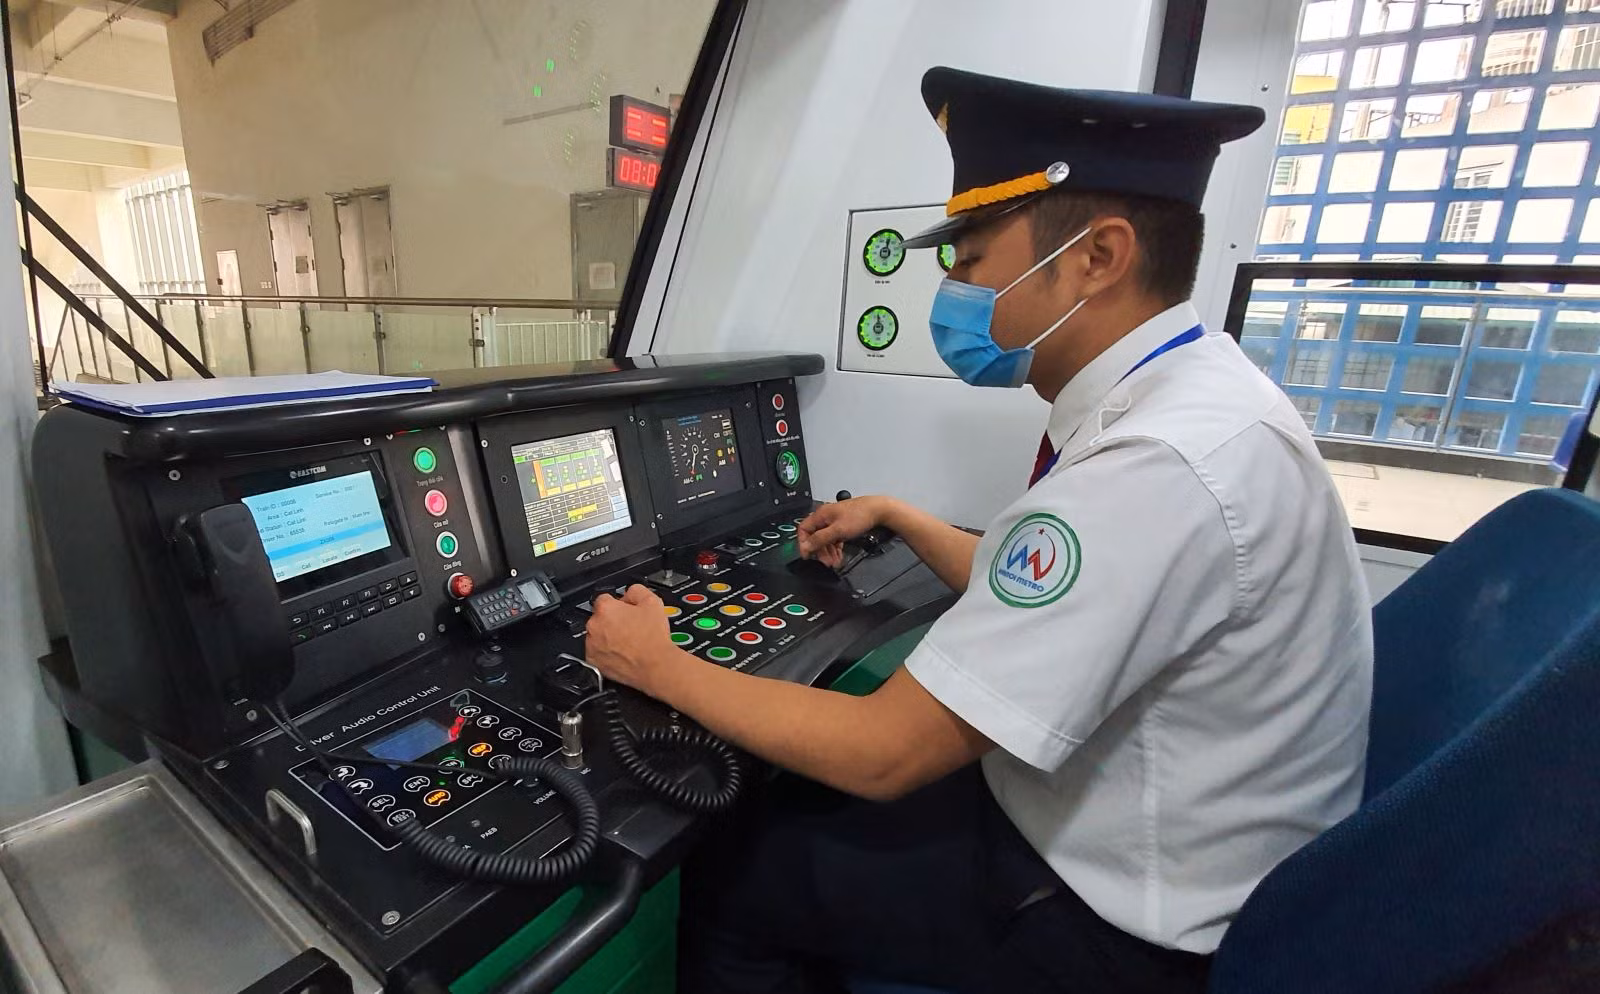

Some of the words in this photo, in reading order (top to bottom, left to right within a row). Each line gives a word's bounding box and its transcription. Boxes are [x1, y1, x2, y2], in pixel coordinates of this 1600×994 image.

[1015, 576, 1045, 593] METRO
[294, 731, 335, 752] Diver
[341, 714, 376, 733] Audio
[376, 695, 418, 716] Control
[416, 685, 441, 699] Unit
[502, 729, 517, 738] RST
[408, 778, 427, 789] ENT
[371, 797, 391, 808] SEL
[428, 791, 446, 804] AUTO
[532, 789, 557, 805] VOLUME
